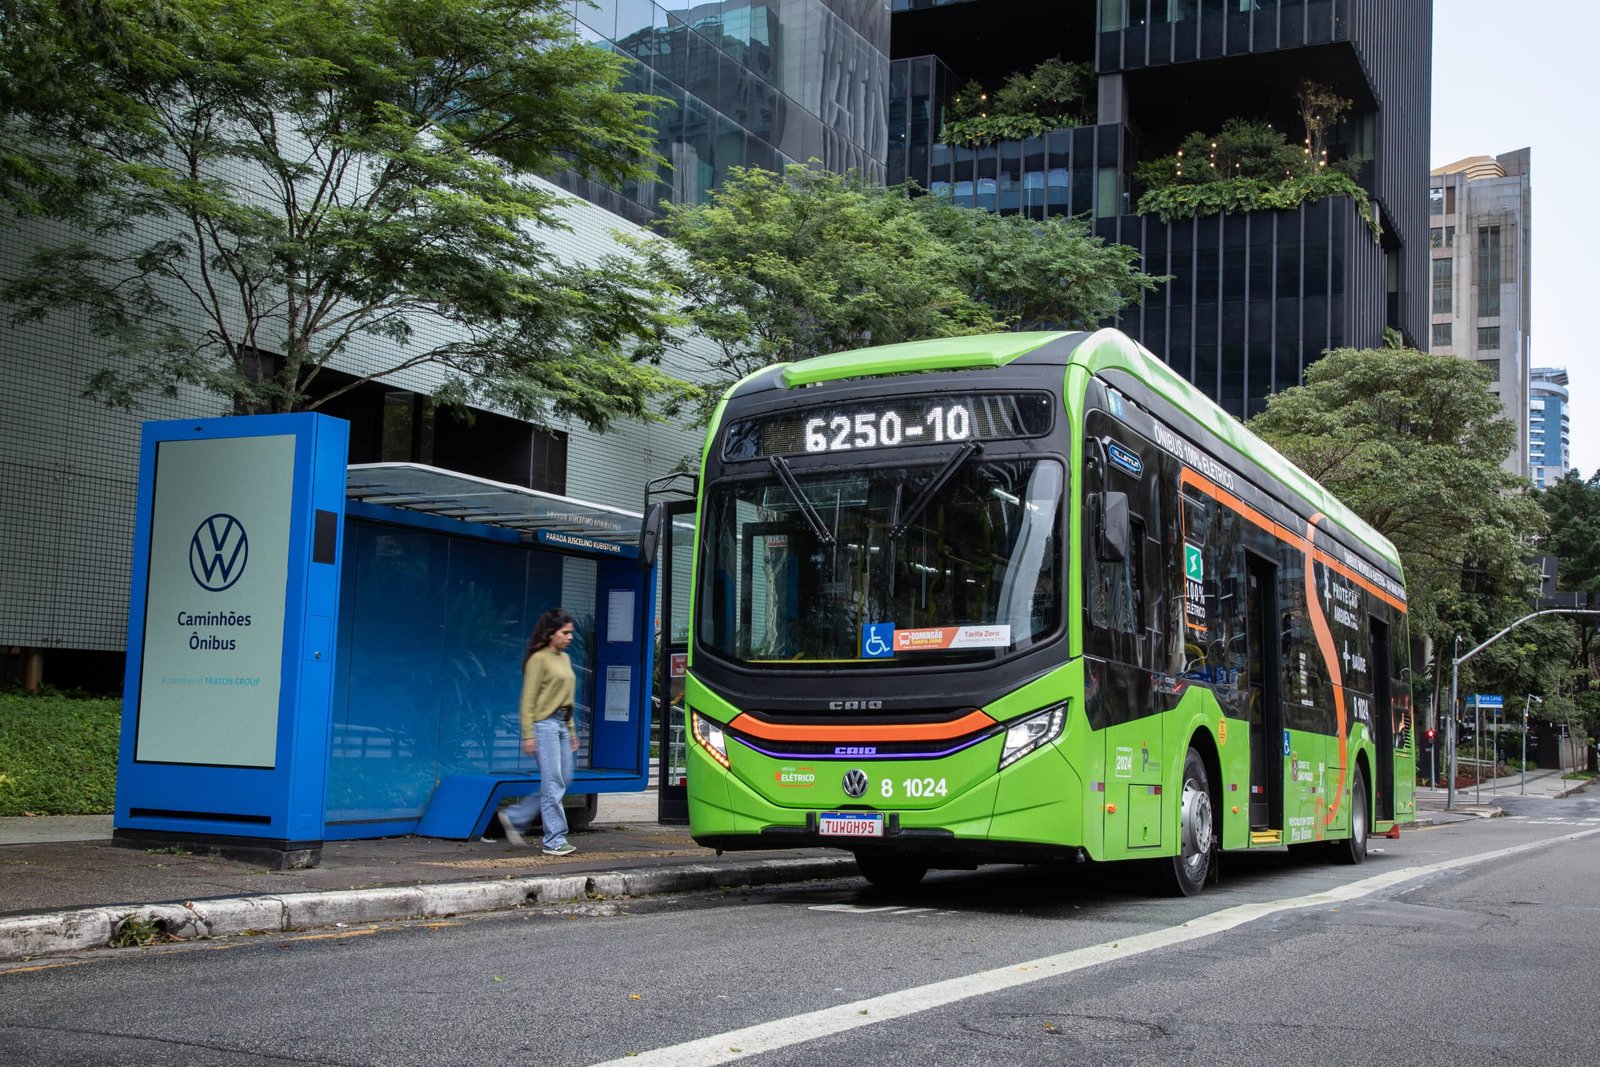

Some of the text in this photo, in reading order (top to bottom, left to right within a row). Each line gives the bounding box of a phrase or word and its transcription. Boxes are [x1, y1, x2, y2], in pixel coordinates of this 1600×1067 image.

[804, 404, 970, 453] 6250-10
[1153, 420, 1184, 459] ÔNIBUS
[1184, 444, 1203, 472] 100%
[1202, 455, 1234, 491] ELÉTRICO
[545, 532, 567, 544] PARADA
[567, 536, 592, 548] JUSCELINO
[1186, 580, 1206, 605] 100%
[1186, 601, 1206, 619] ELÉTRICO
[177, 611, 252, 626] Caminhões
[189, 631, 236, 650] Ônibus
[911, 629, 943, 640] DOMINGÃO
[964, 630, 983, 638] Tarifa
[1352, 652, 1367, 674] SAÚDE
[205, 676, 233, 685] TRATON
[235, 677, 260, 686] GROUP
[829, 700, 882, 710] CAIO
[1357, 697, 1369, 721] 1024
[834, 746, 877, 755] CAIO
[1117, 755, 1132, 770] 2024
[781, 772, 815, 782] ELÉTRICO
[881, 777, 948, 798] 8 1024
